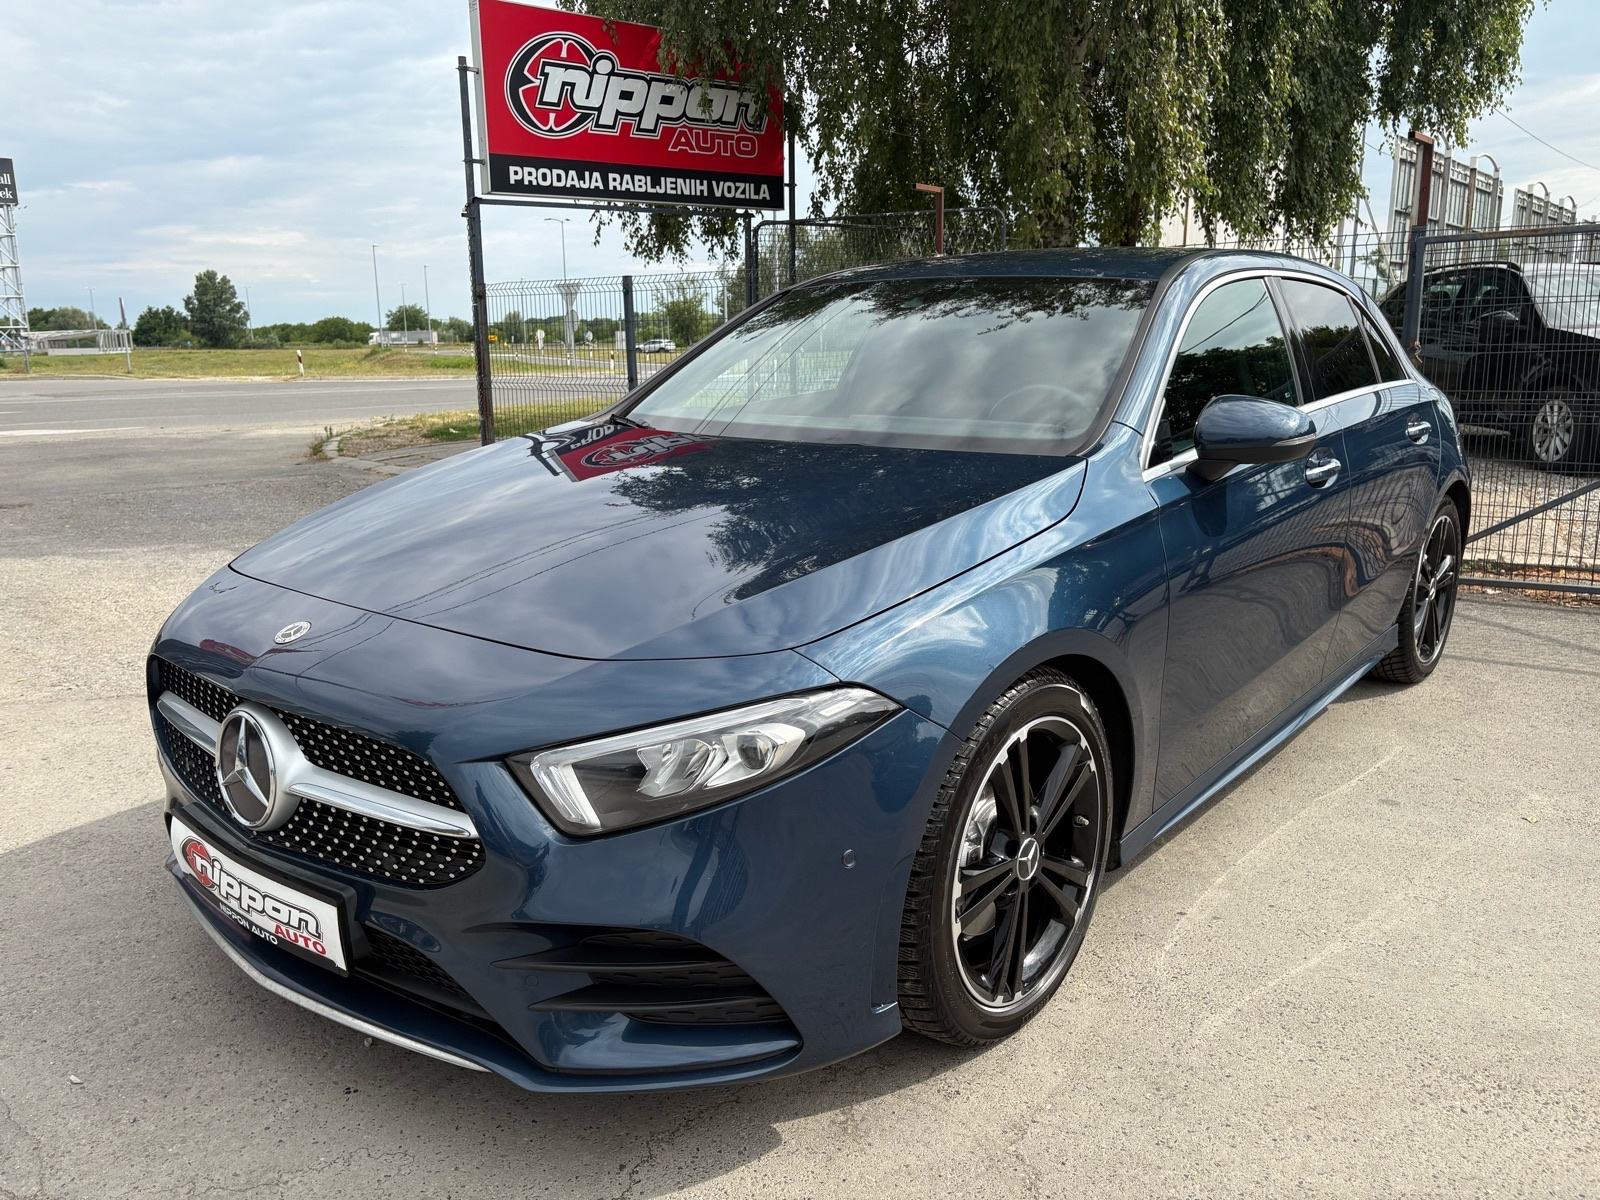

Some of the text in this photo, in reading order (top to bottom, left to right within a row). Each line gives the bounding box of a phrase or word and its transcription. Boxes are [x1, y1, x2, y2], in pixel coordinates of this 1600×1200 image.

[668, 127, 758, 158] AUTO
[508, 165, 771, 201] PRODAJA RABLJENIH VOZILA
[191, 850, 323, 940] nippon
[219, 901, 278, 945] NIPPON AUTO
[273, 922, 327, 956] AUTO
